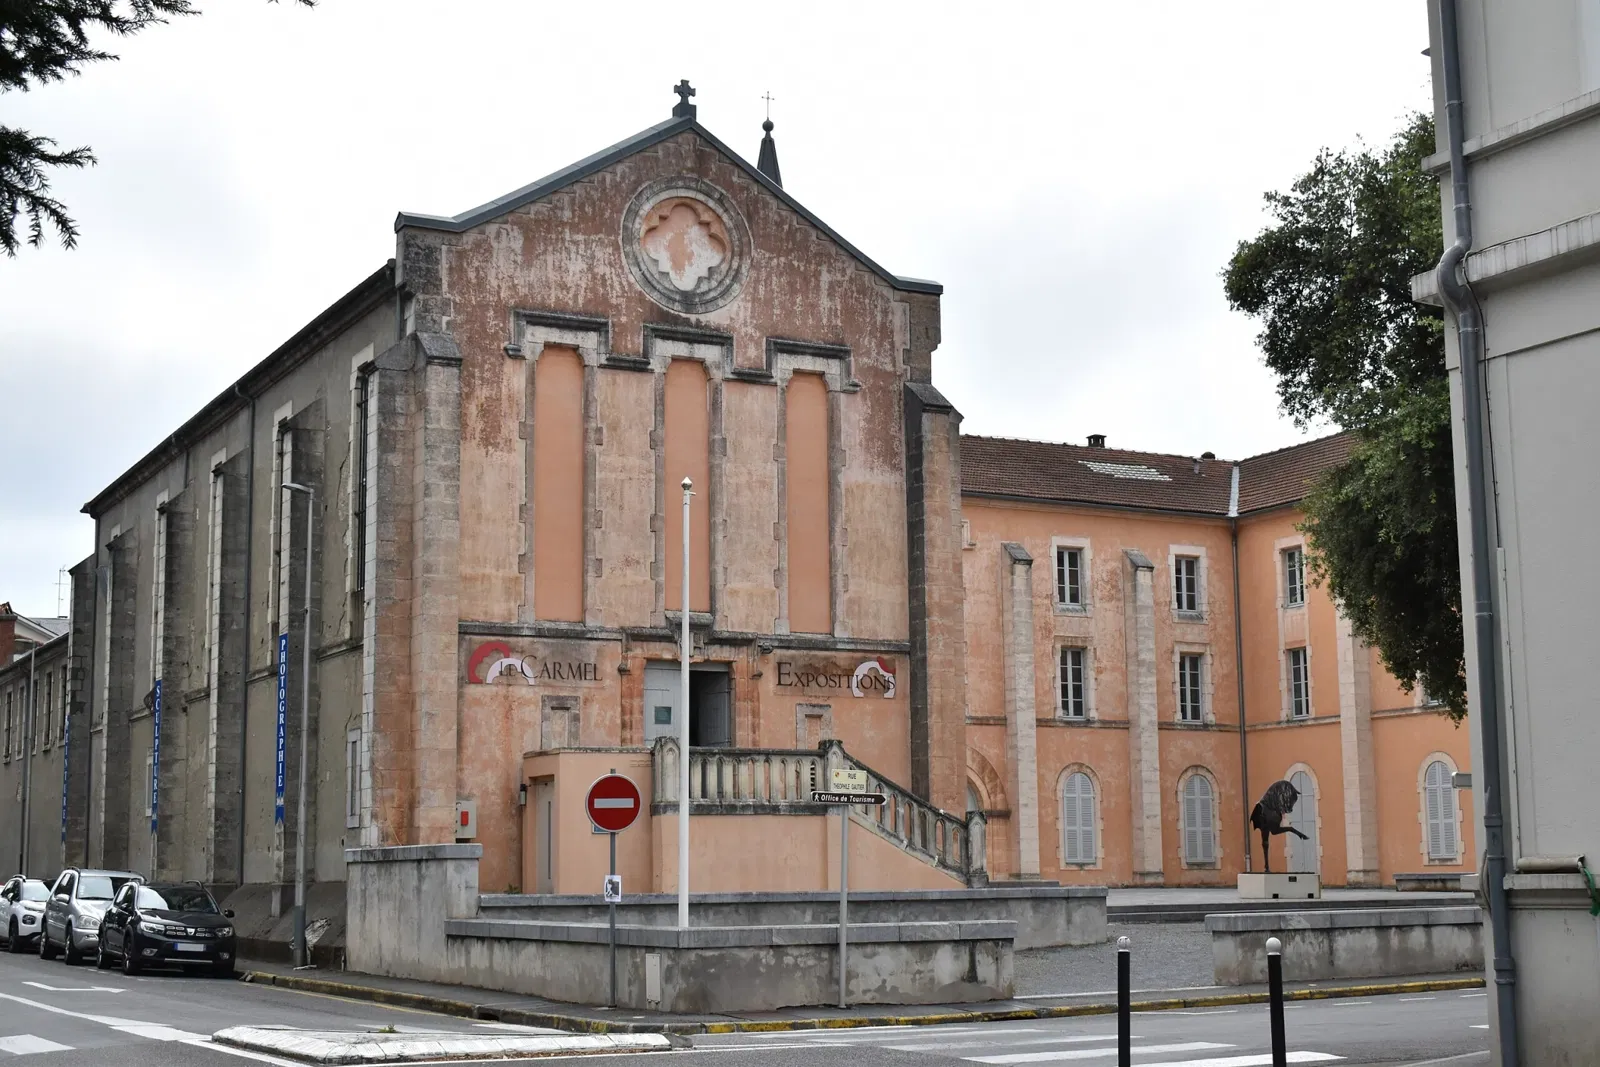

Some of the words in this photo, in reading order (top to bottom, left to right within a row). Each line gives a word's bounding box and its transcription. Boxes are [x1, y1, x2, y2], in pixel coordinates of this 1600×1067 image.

[499, 661, 516, 677] LE
[520, 655, 603, 681] CARMEL
[776, 661, 896, 691] EXPOSITIONS
[278, 639, 286, 787] PHOTOGRAPHIE
[153, 685, 161, 804] SCULPTURE
[849, 795, 875, 803] Tourisme
